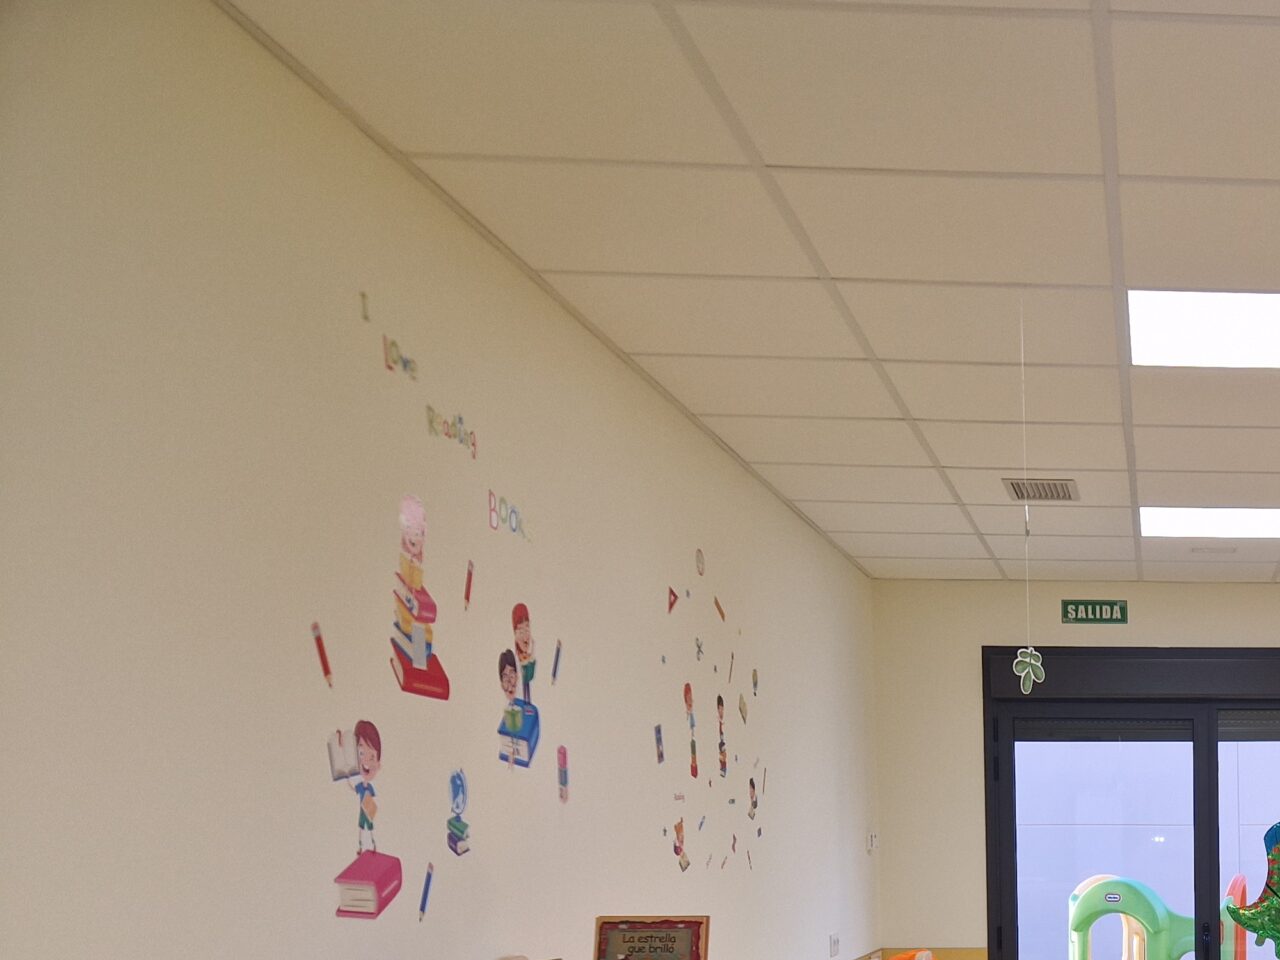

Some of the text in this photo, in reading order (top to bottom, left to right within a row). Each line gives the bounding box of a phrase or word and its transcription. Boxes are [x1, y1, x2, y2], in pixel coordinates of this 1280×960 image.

[1067, 604, 1122, 619] SALIDA
[622, 933, 676, 943] La estrella
[627, 943, 675, 955] que brilló
